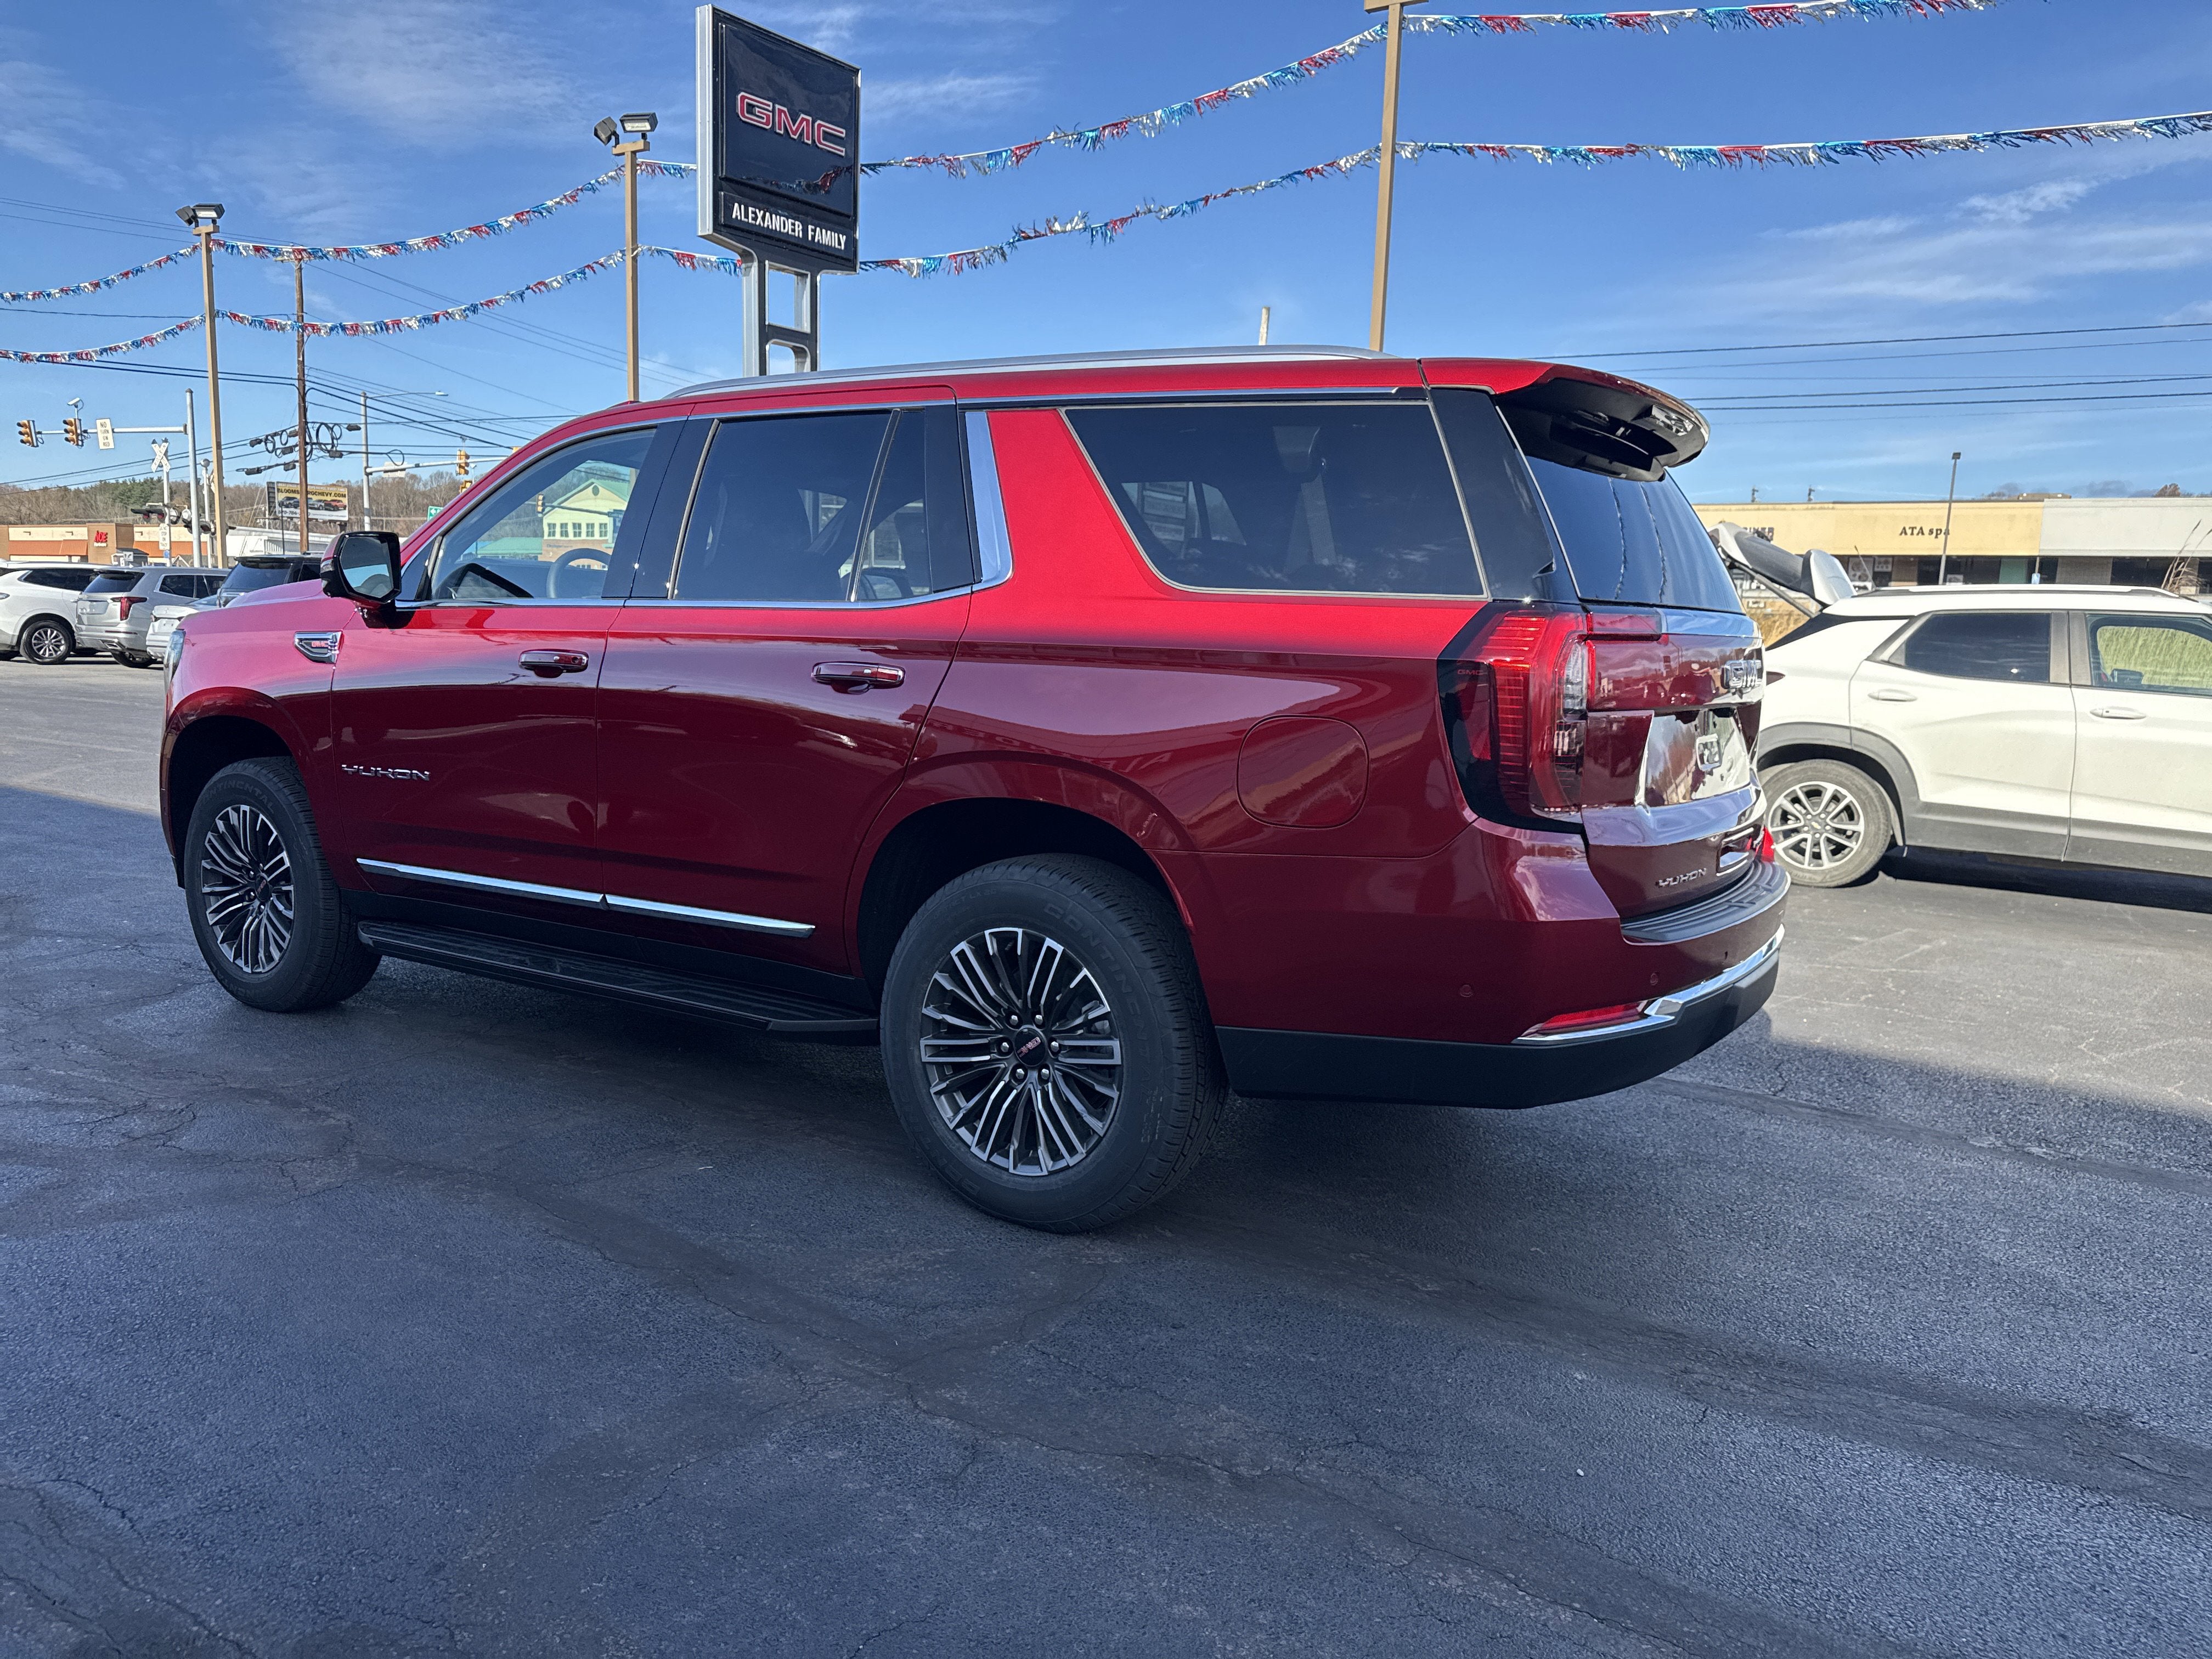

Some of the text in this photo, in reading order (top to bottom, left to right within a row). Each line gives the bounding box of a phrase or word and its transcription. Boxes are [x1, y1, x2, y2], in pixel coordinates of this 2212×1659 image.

[737, 92, 846, 156] GMC
[732, 202, 847, 251] ALEXANDER FAMILY
[1899, 526, 1925, 536] ATA
[341, 764, 430, 781] YUKON
[1657, 867, 1707, 888] YUKON
[1043, 900, 1150, 1103] CONTINENTAL
[1017, 1037, 1041, 1058] GMC
